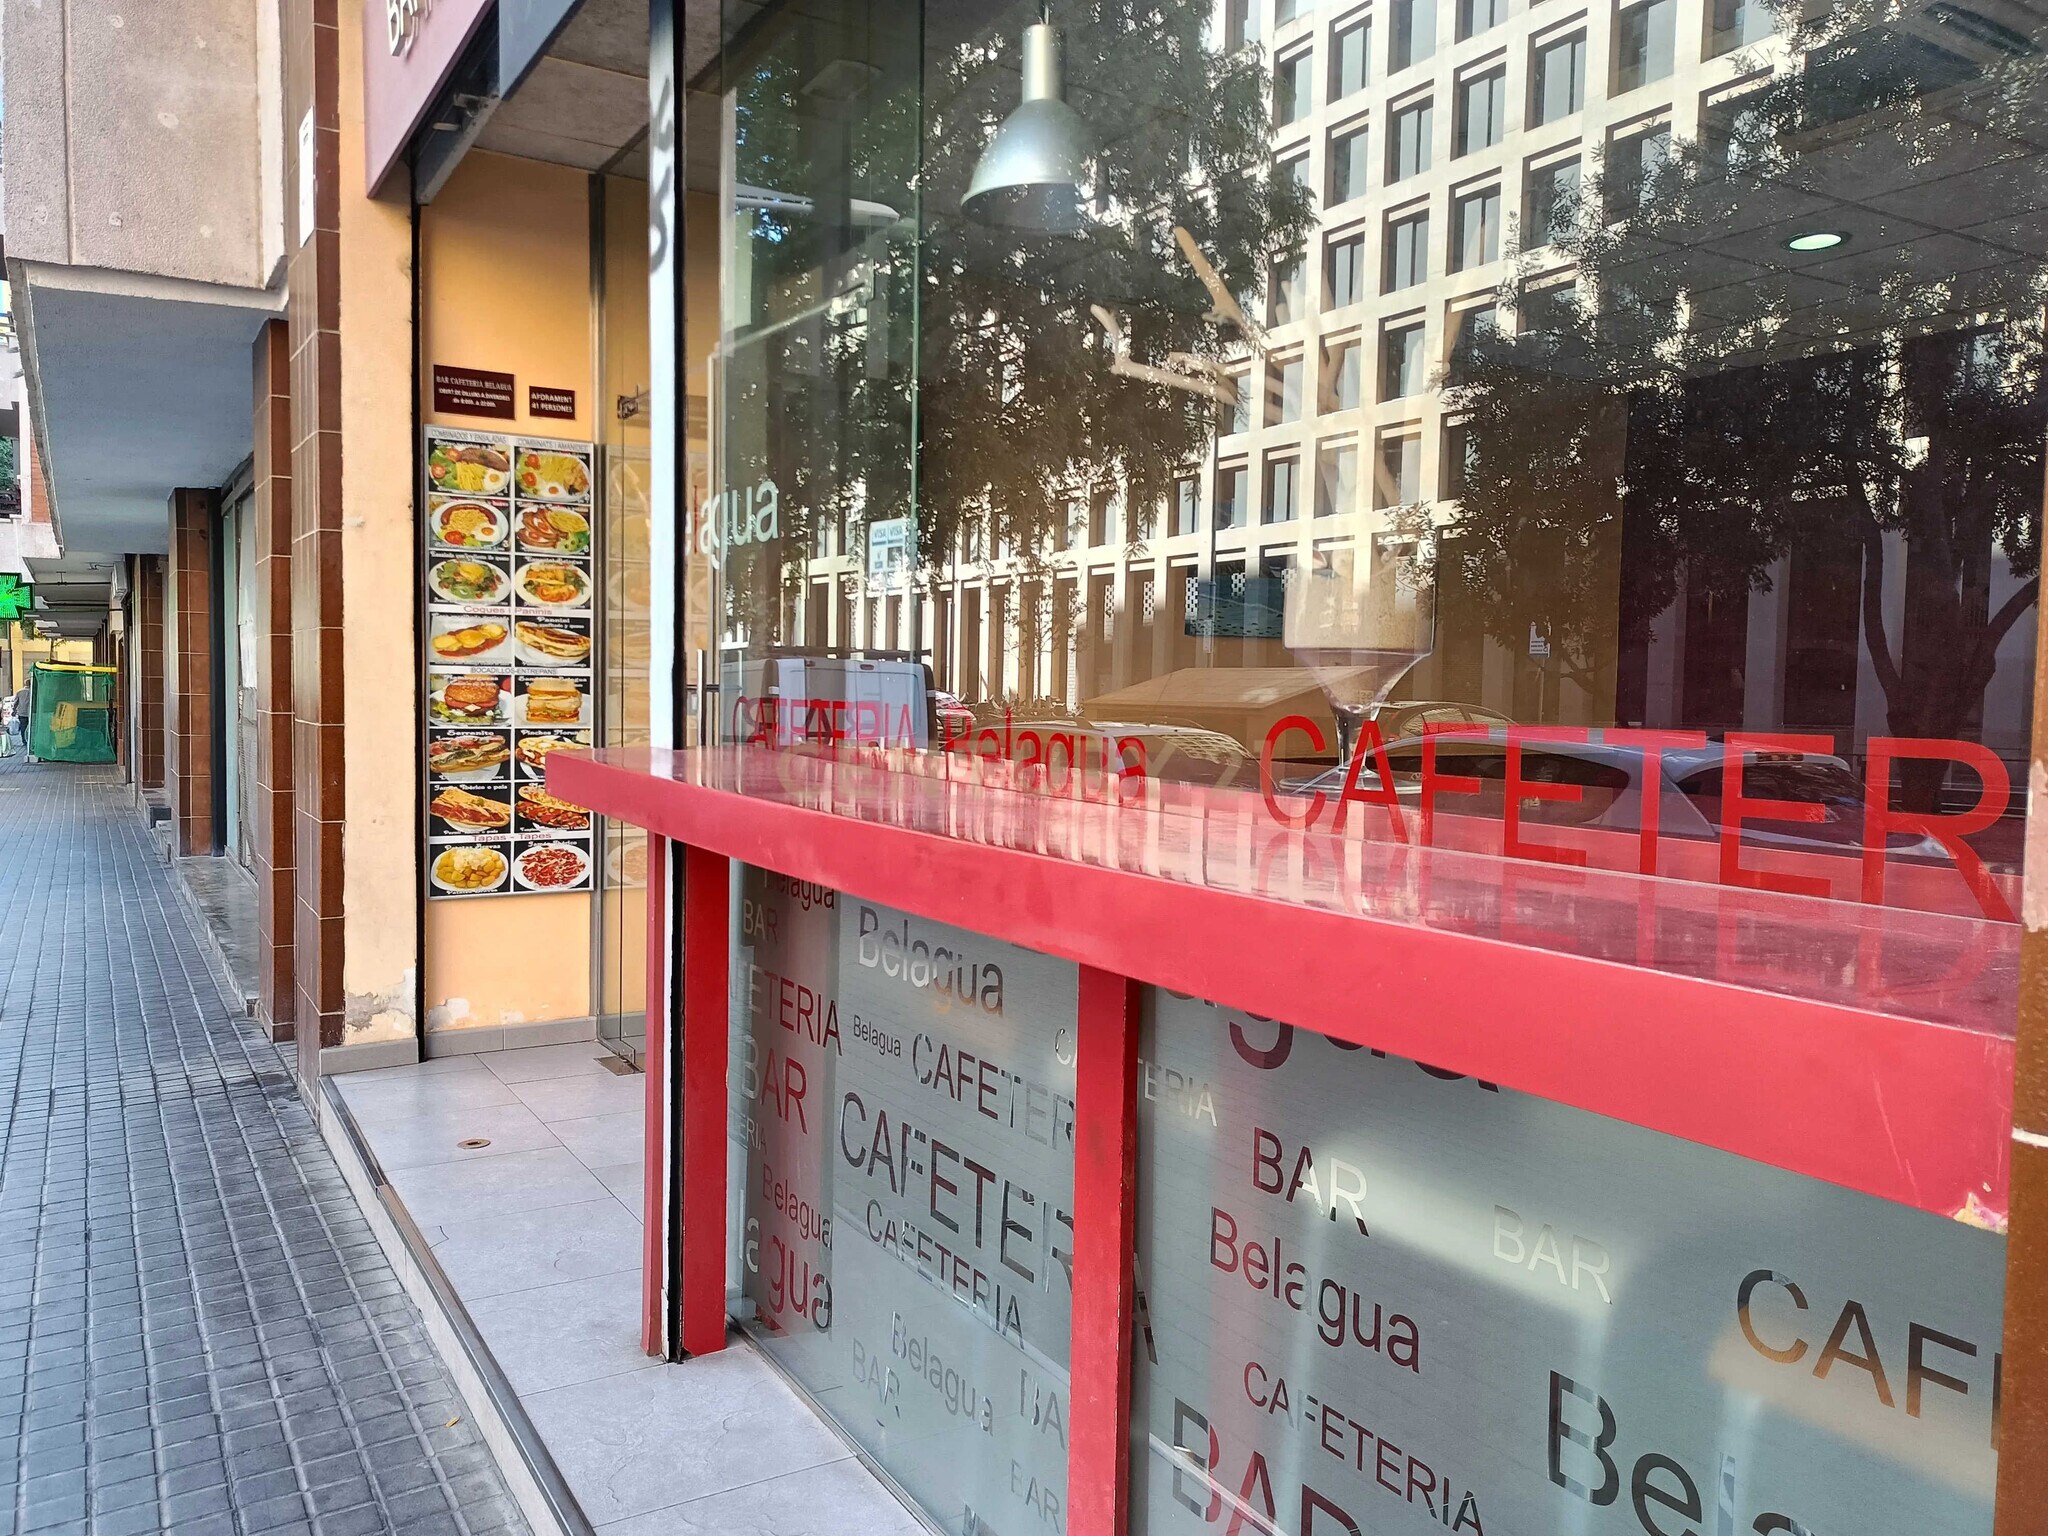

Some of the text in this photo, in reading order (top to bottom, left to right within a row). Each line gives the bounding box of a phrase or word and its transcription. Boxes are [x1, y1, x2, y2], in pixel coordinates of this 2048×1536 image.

[464, 605, 505, 614] Coques
[743, 899, 778, 943] BAR
[859, 905, 1003, 1019] Belagua
[741, 1035, 807, 1134] BAR
[853, 1015, 901, 1058] Belagua
[762, 1164, 832, 1251] Belagua
[1253, 1126, 1370, 1237] BAR
[866, 1199, 1025, 1350] CAFETERIA
[1210, 1207, 1421, 1374] Belagua
[1493, 1203, 1612, 1305] BAR
[891, 1310, 994, 1437] Belagua
[1010, 1457, 1061, 1535] BAR
[1243, 1360, 1485, 1536] CAFETERIA
